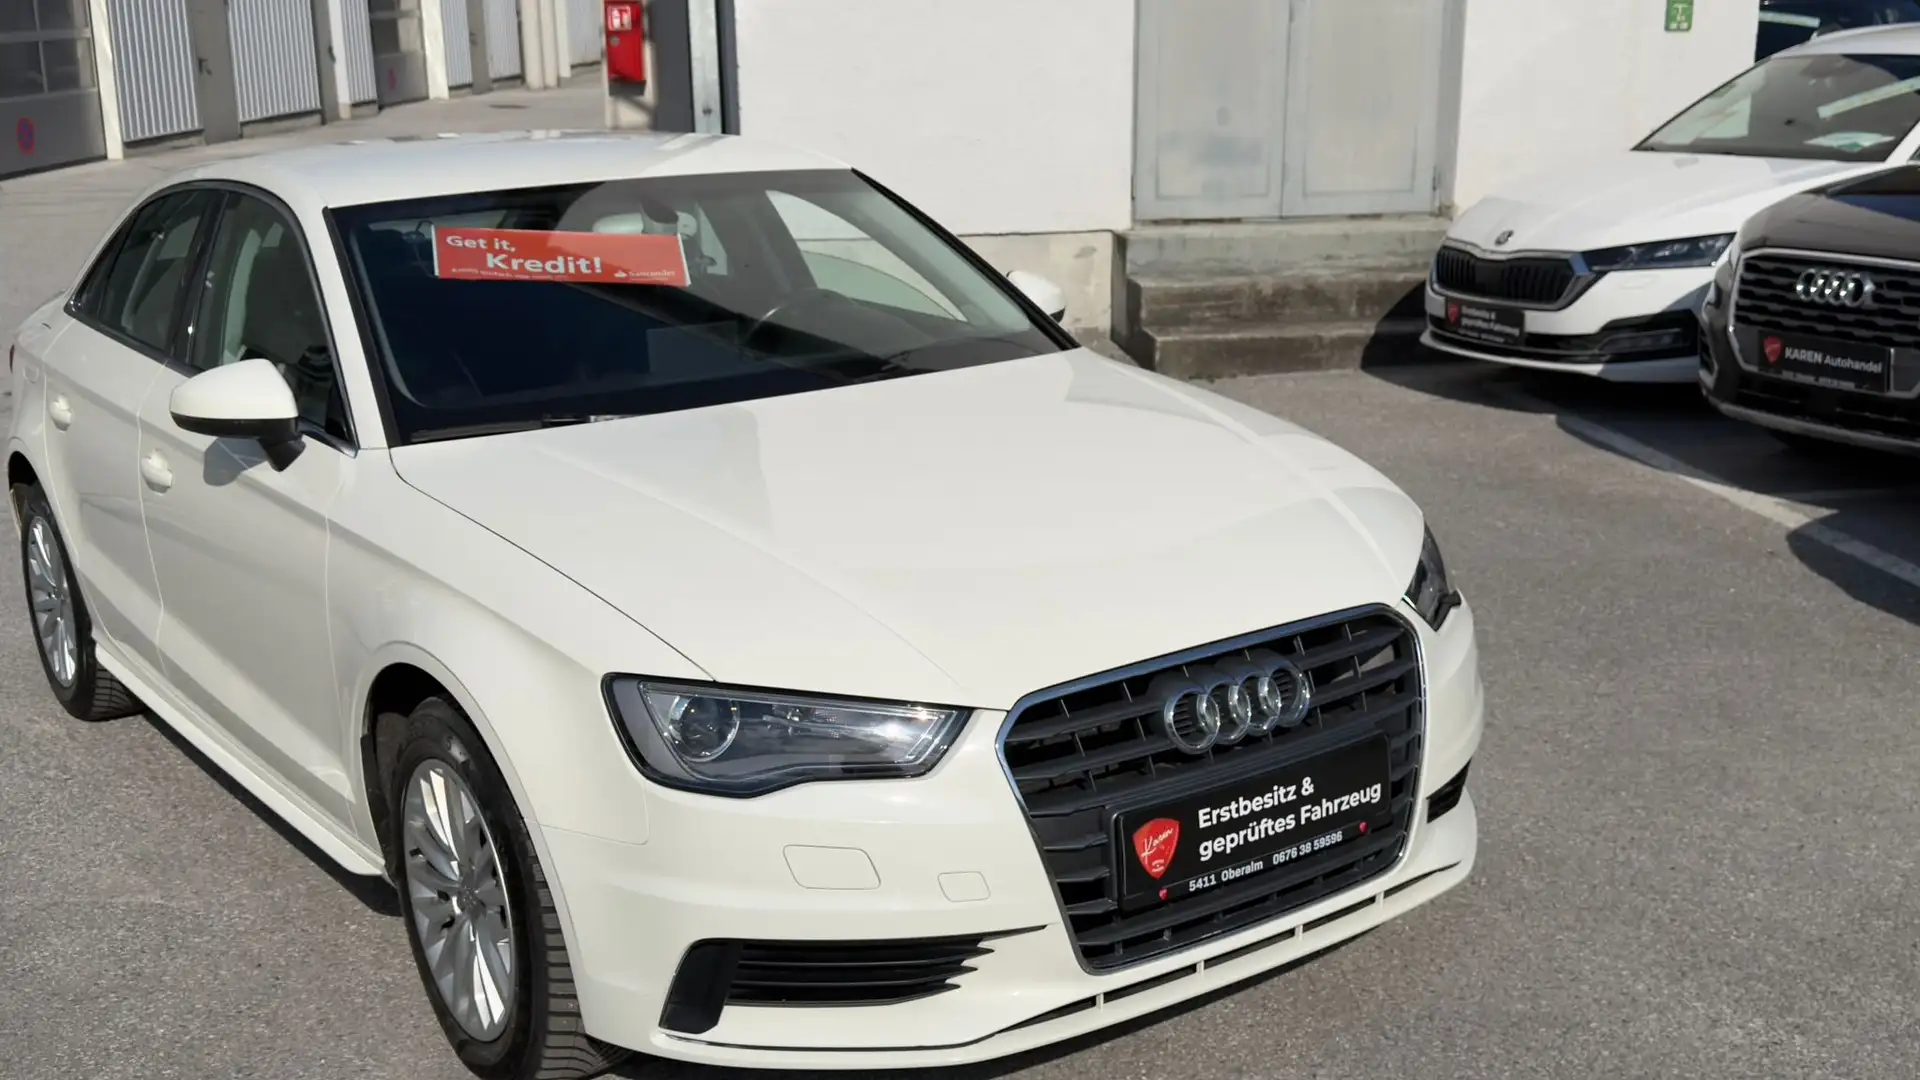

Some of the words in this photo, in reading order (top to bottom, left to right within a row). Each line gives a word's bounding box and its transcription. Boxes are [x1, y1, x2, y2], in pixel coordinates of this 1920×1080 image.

[446, 235, 489, 249] Get
[494, 238, 515, 252] it,
[486, 253, 602, 274] Kredit!
[1785, 347, 1822, 365] KAREN
[1824, 355, 1882, 373] Autohandel
[1198, 784, 1296, 829] Erstbesitz
[1302, 776, 1314, 796] &
[1199, 814, 1296, 861] geprüftes
[1300, 783, 1381, 825] Fahrzeug
[1189, 876, 1216, 891] 5411
[1221, 859, 1263, 881] Oberalm
[1273, 847, 1297, 865] 0676
[1299, 843, 1311, 856] 38
[1314, 831, 1342, 850] 59596
